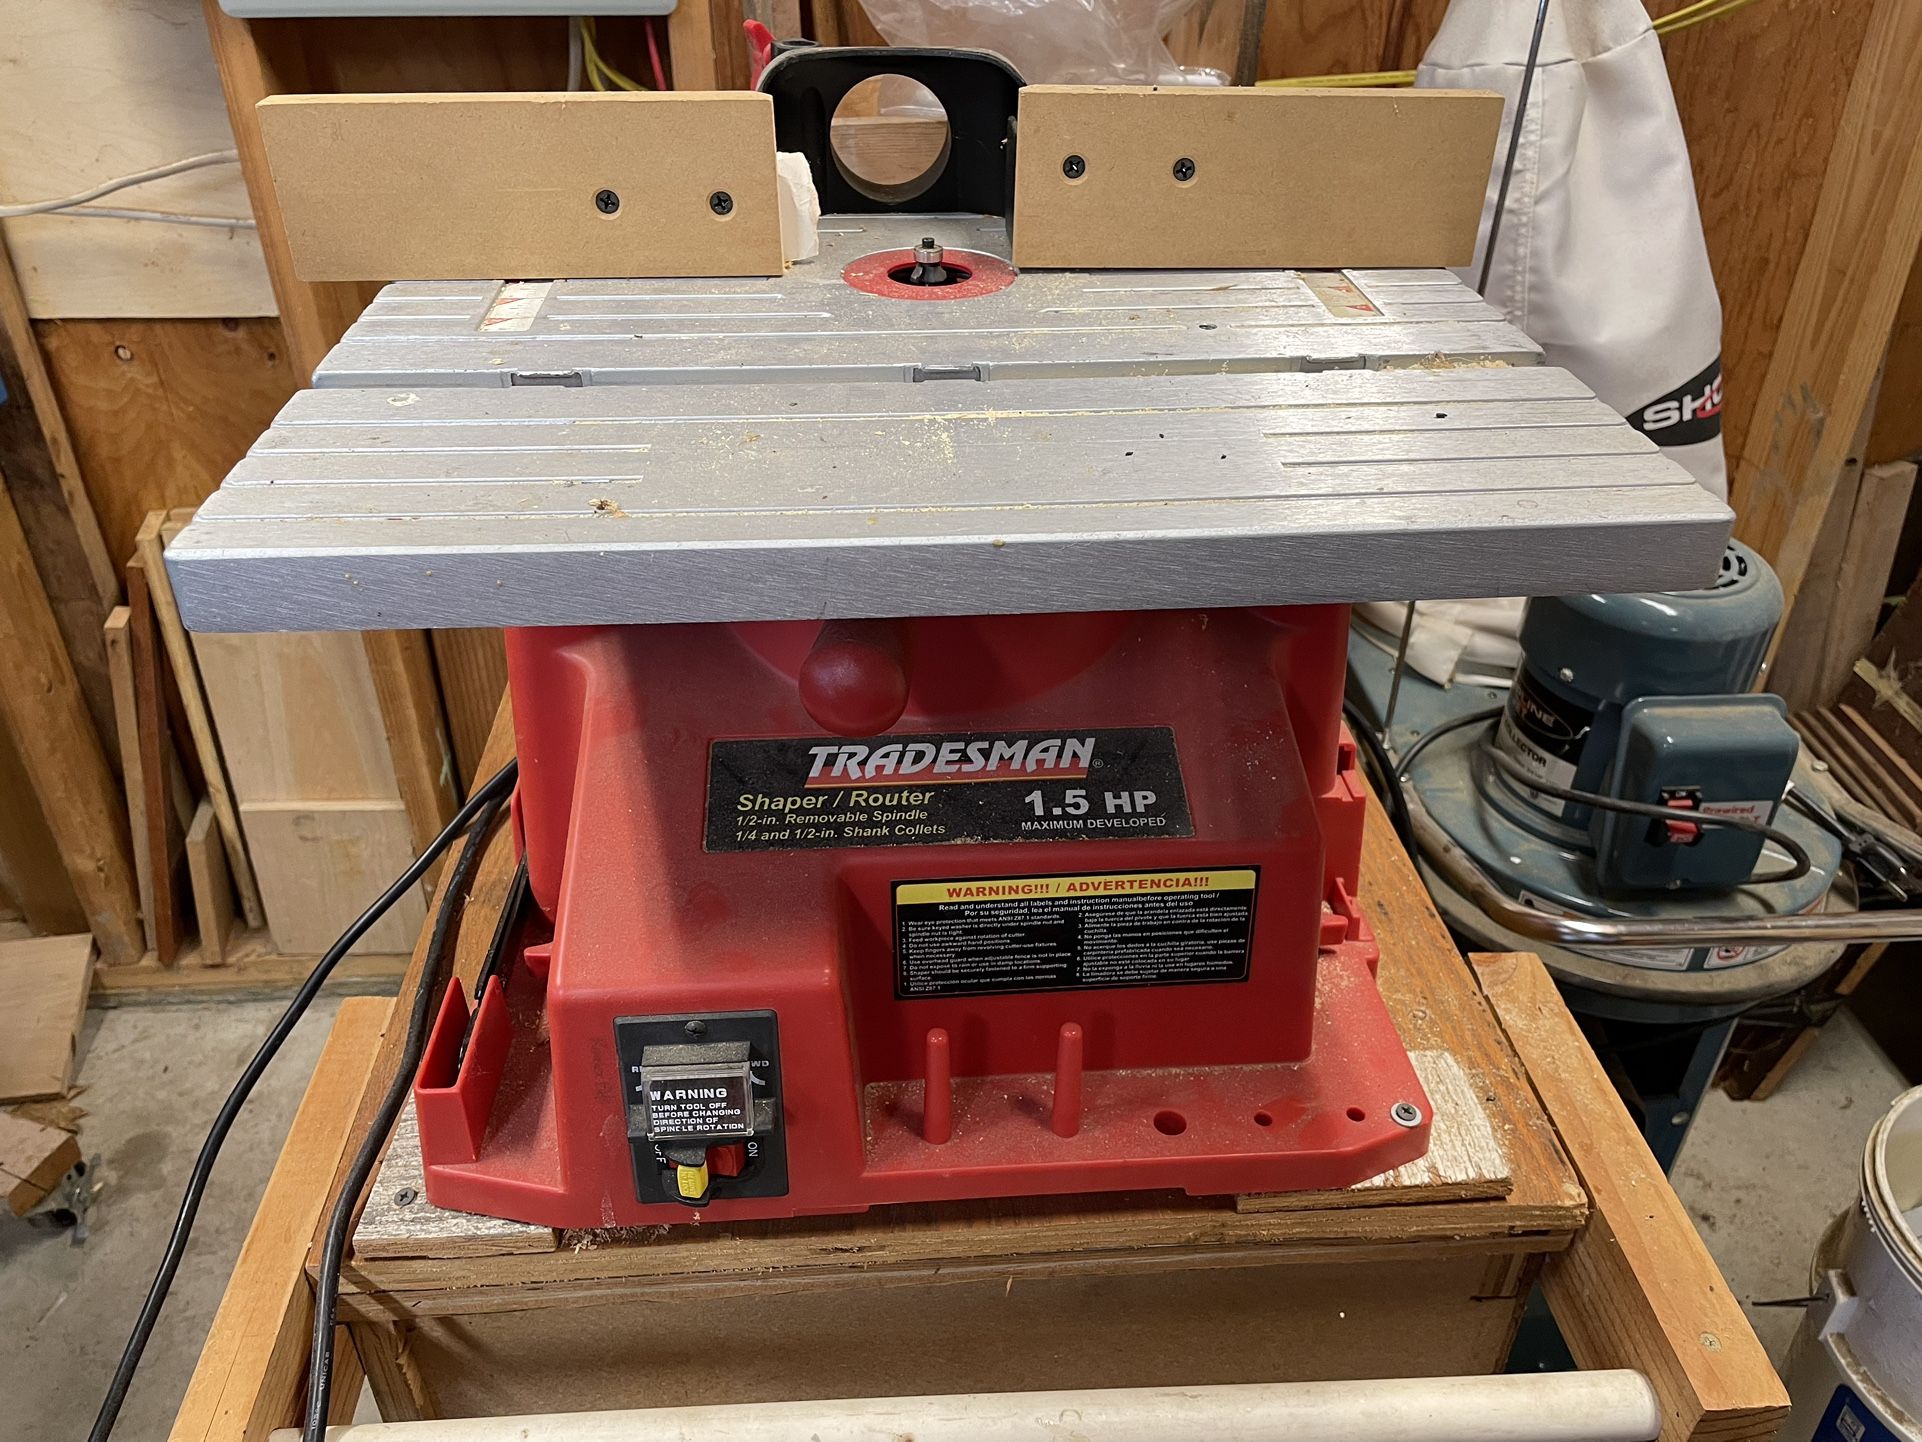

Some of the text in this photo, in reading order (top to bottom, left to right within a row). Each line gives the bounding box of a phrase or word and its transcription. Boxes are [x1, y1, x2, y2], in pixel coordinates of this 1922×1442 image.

[808, 738, 1095, 780] TRADESMAN
[736, 790, 935, 813] Shaper / Router
[1024, 789, 1157, 816] 1.5 HP
[736, 810, 928, 826] 1/2-in. Removable Spindle
[1021, 817, 1166, 830] MAXIMUM DEVELOPED
[736, 823, 946, 842] 1/4 and 1/2-in. Shank Collets
[947, 876, 1210, 898] WARNING!!! / ADVERTENCIA!!!
[1163, 893, 1198, 901] operating
[990, 907, 1029, 916] seguridad,
[650, 1088, 728, 1100] WARNING
[692, 1109, 741, 1117] CHANGING
[696, 1123, 745, 1131] ROTATION
[748, 1142, 758, 1157] ON
